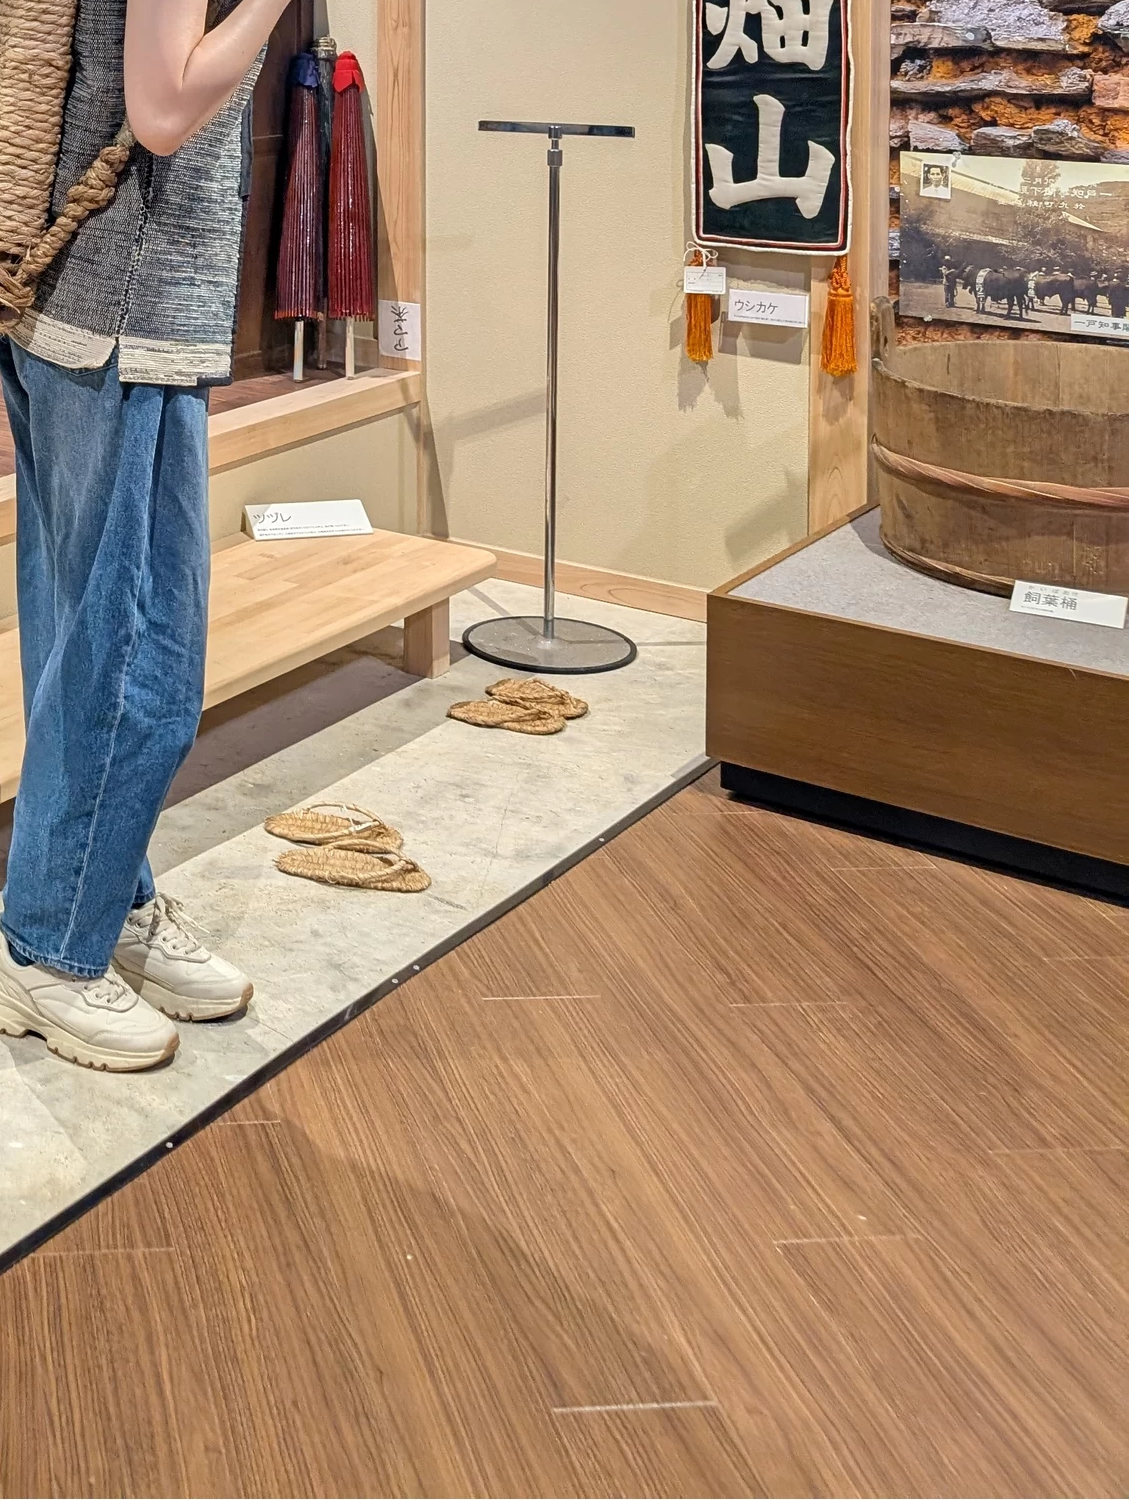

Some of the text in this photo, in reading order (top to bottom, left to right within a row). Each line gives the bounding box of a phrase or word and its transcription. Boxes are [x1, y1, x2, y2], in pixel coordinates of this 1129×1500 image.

[734, 299, 779, 315] ウシカケ
[253, 512, 292, 524] ツヅレ
[1023, 591, 1078, 611] 飼葉桶
